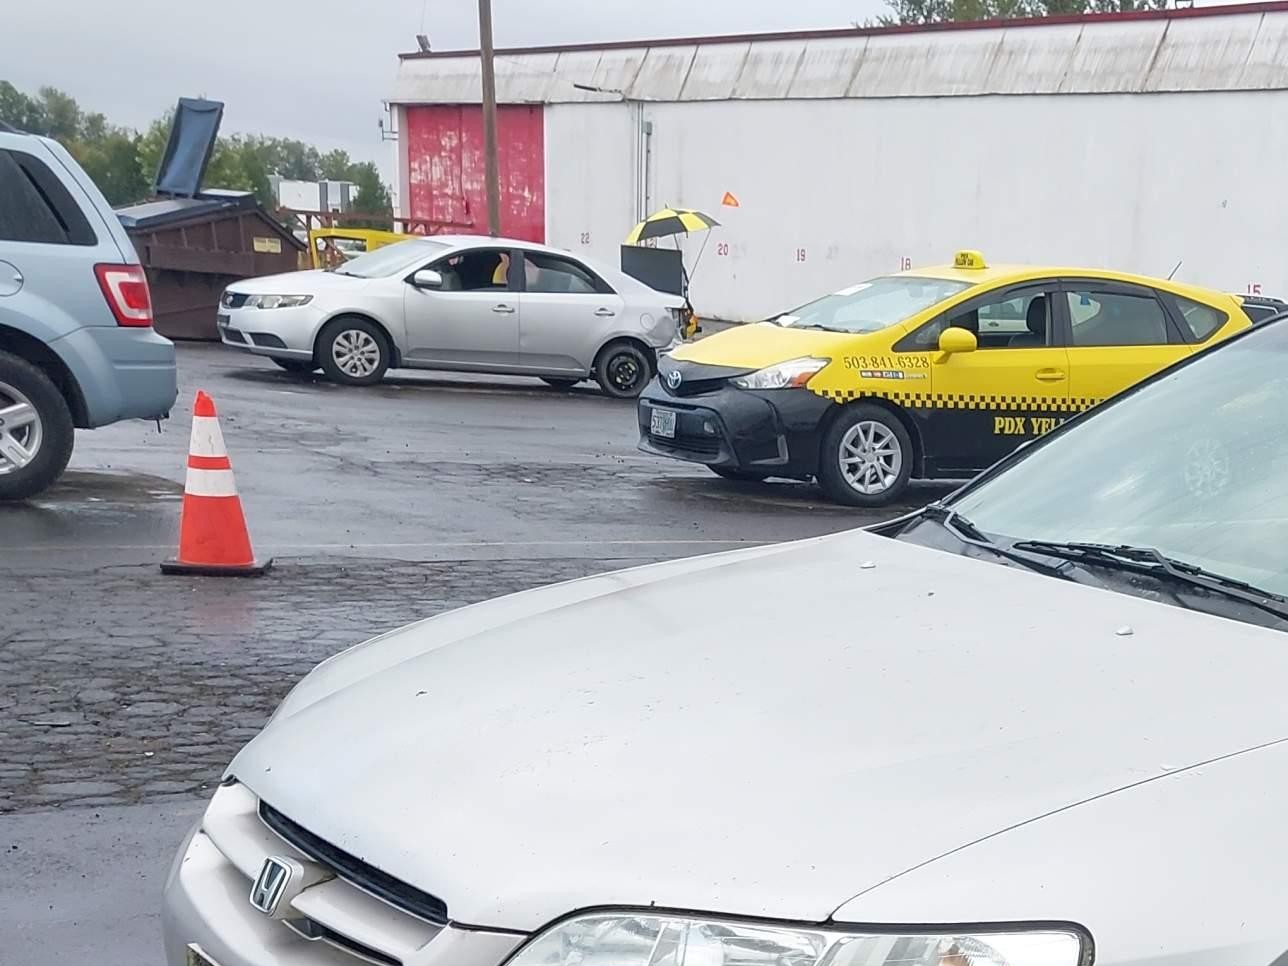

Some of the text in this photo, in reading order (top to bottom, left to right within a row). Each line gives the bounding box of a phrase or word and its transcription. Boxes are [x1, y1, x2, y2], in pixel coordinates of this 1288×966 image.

[580, 232, 591, 245] 22
[717, 243, 729, 256] 20
[796, 248, 806, 262] 19
[900, 257, 912, 271] 18
[993, 416, 1026, 435] PDX
